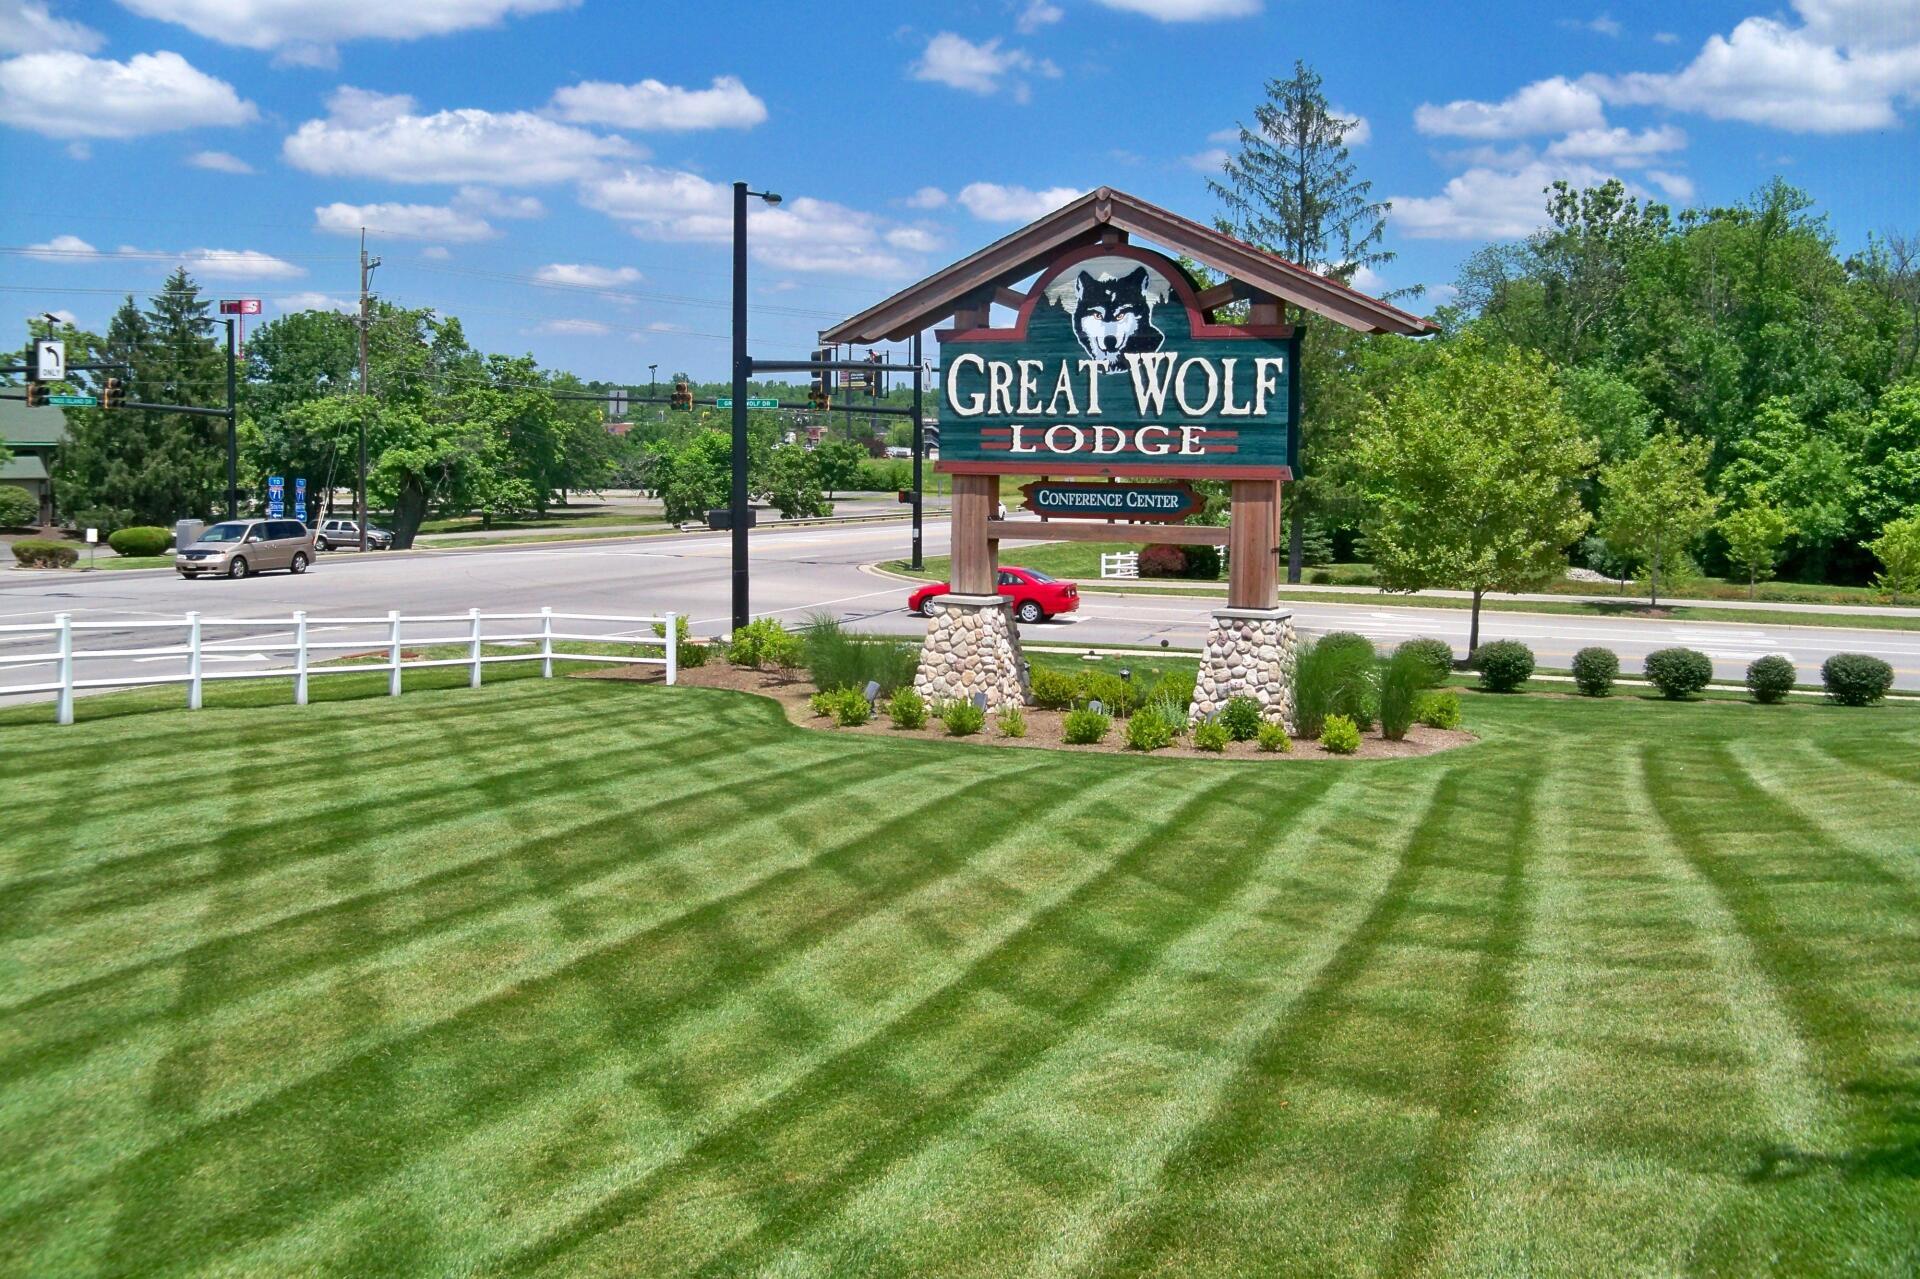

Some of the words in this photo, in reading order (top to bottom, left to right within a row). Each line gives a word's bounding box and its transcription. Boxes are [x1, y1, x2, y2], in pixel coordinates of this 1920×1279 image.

[43, 369, 60, 377] ONLY
[947, 353, 1110, 416] GREAT
[1124, 351, 1283, 416] WOLF
[1009, 424, 1207, 455] LODGE
[271, 490, 281, 500] 71
[1038, 489, 1123, 507] CONFERENCE
[1126, 491, 1179, 508] CENTER
